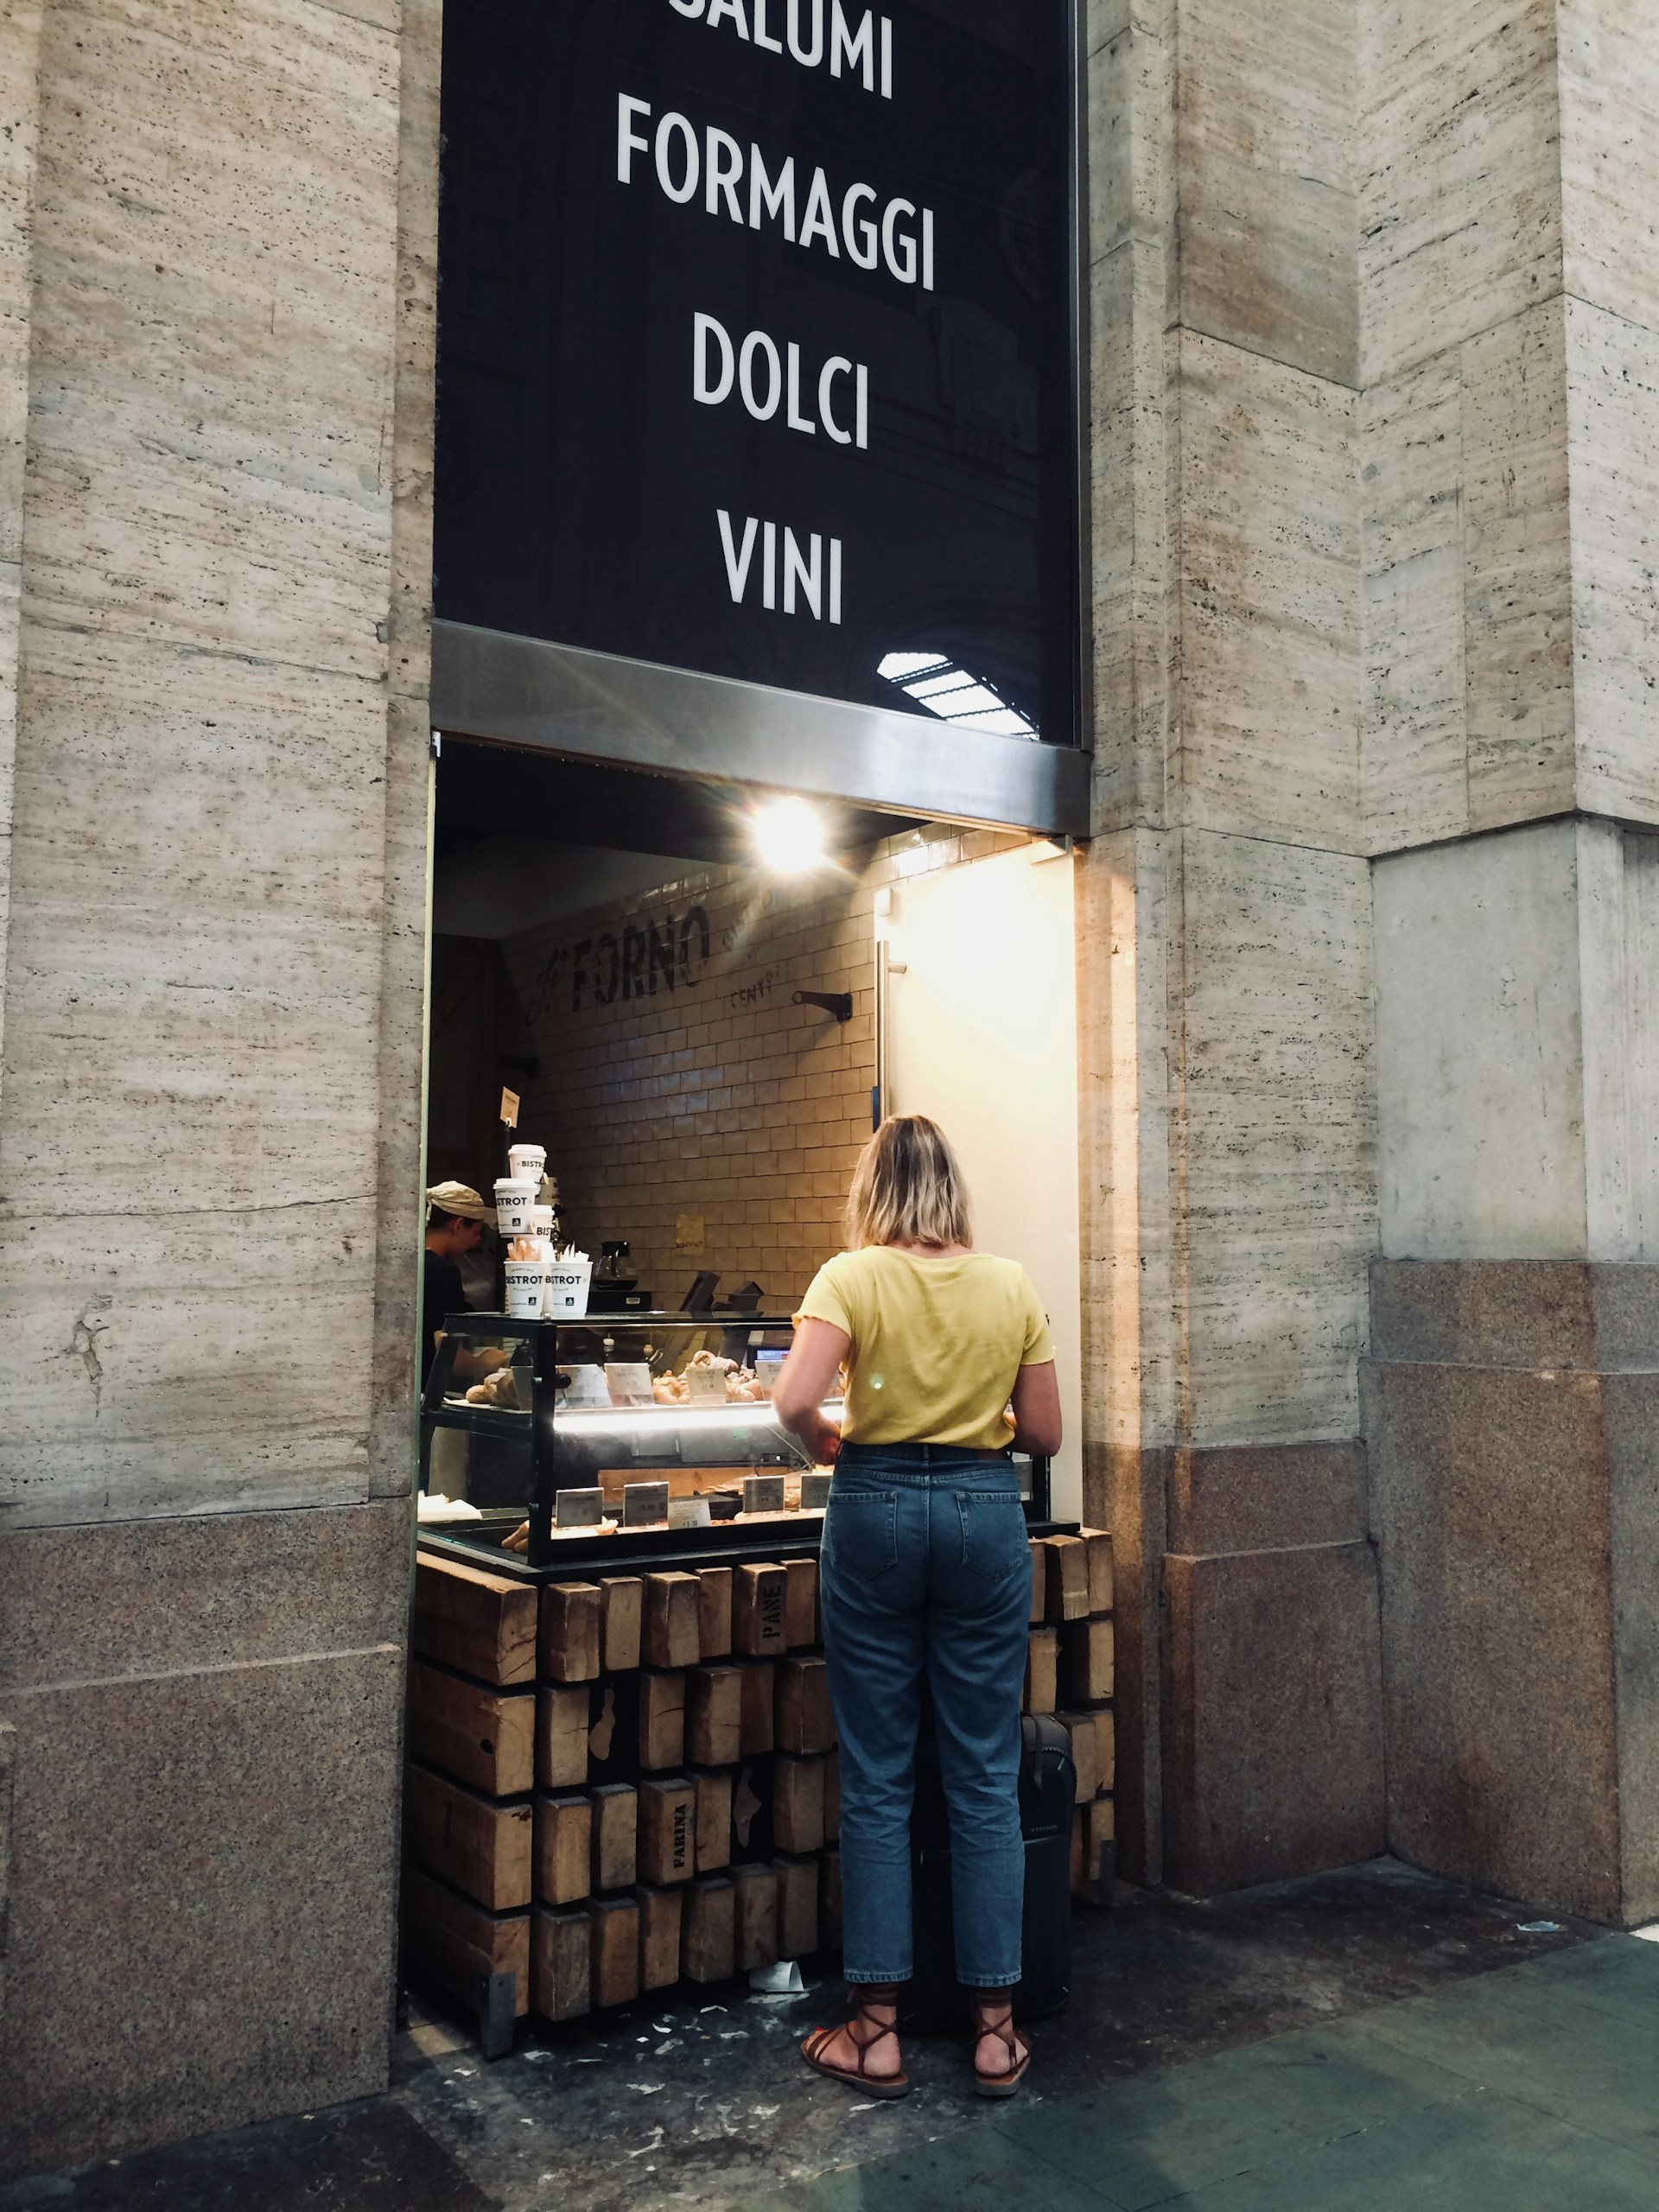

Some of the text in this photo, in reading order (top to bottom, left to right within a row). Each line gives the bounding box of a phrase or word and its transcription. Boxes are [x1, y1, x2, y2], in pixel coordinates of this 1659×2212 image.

[669, 0, 892, 99] LUMI
[617, 92, 934, 291] FORMAGGI
[693, 311, 868, 449] DOLCI
[716, 509, 842, 625] VINI
[572, 906, 710, 1012] FORNO
[761, 1585, 781, 1639] PANE
[673, 1803, 687, 1869] FARINA
